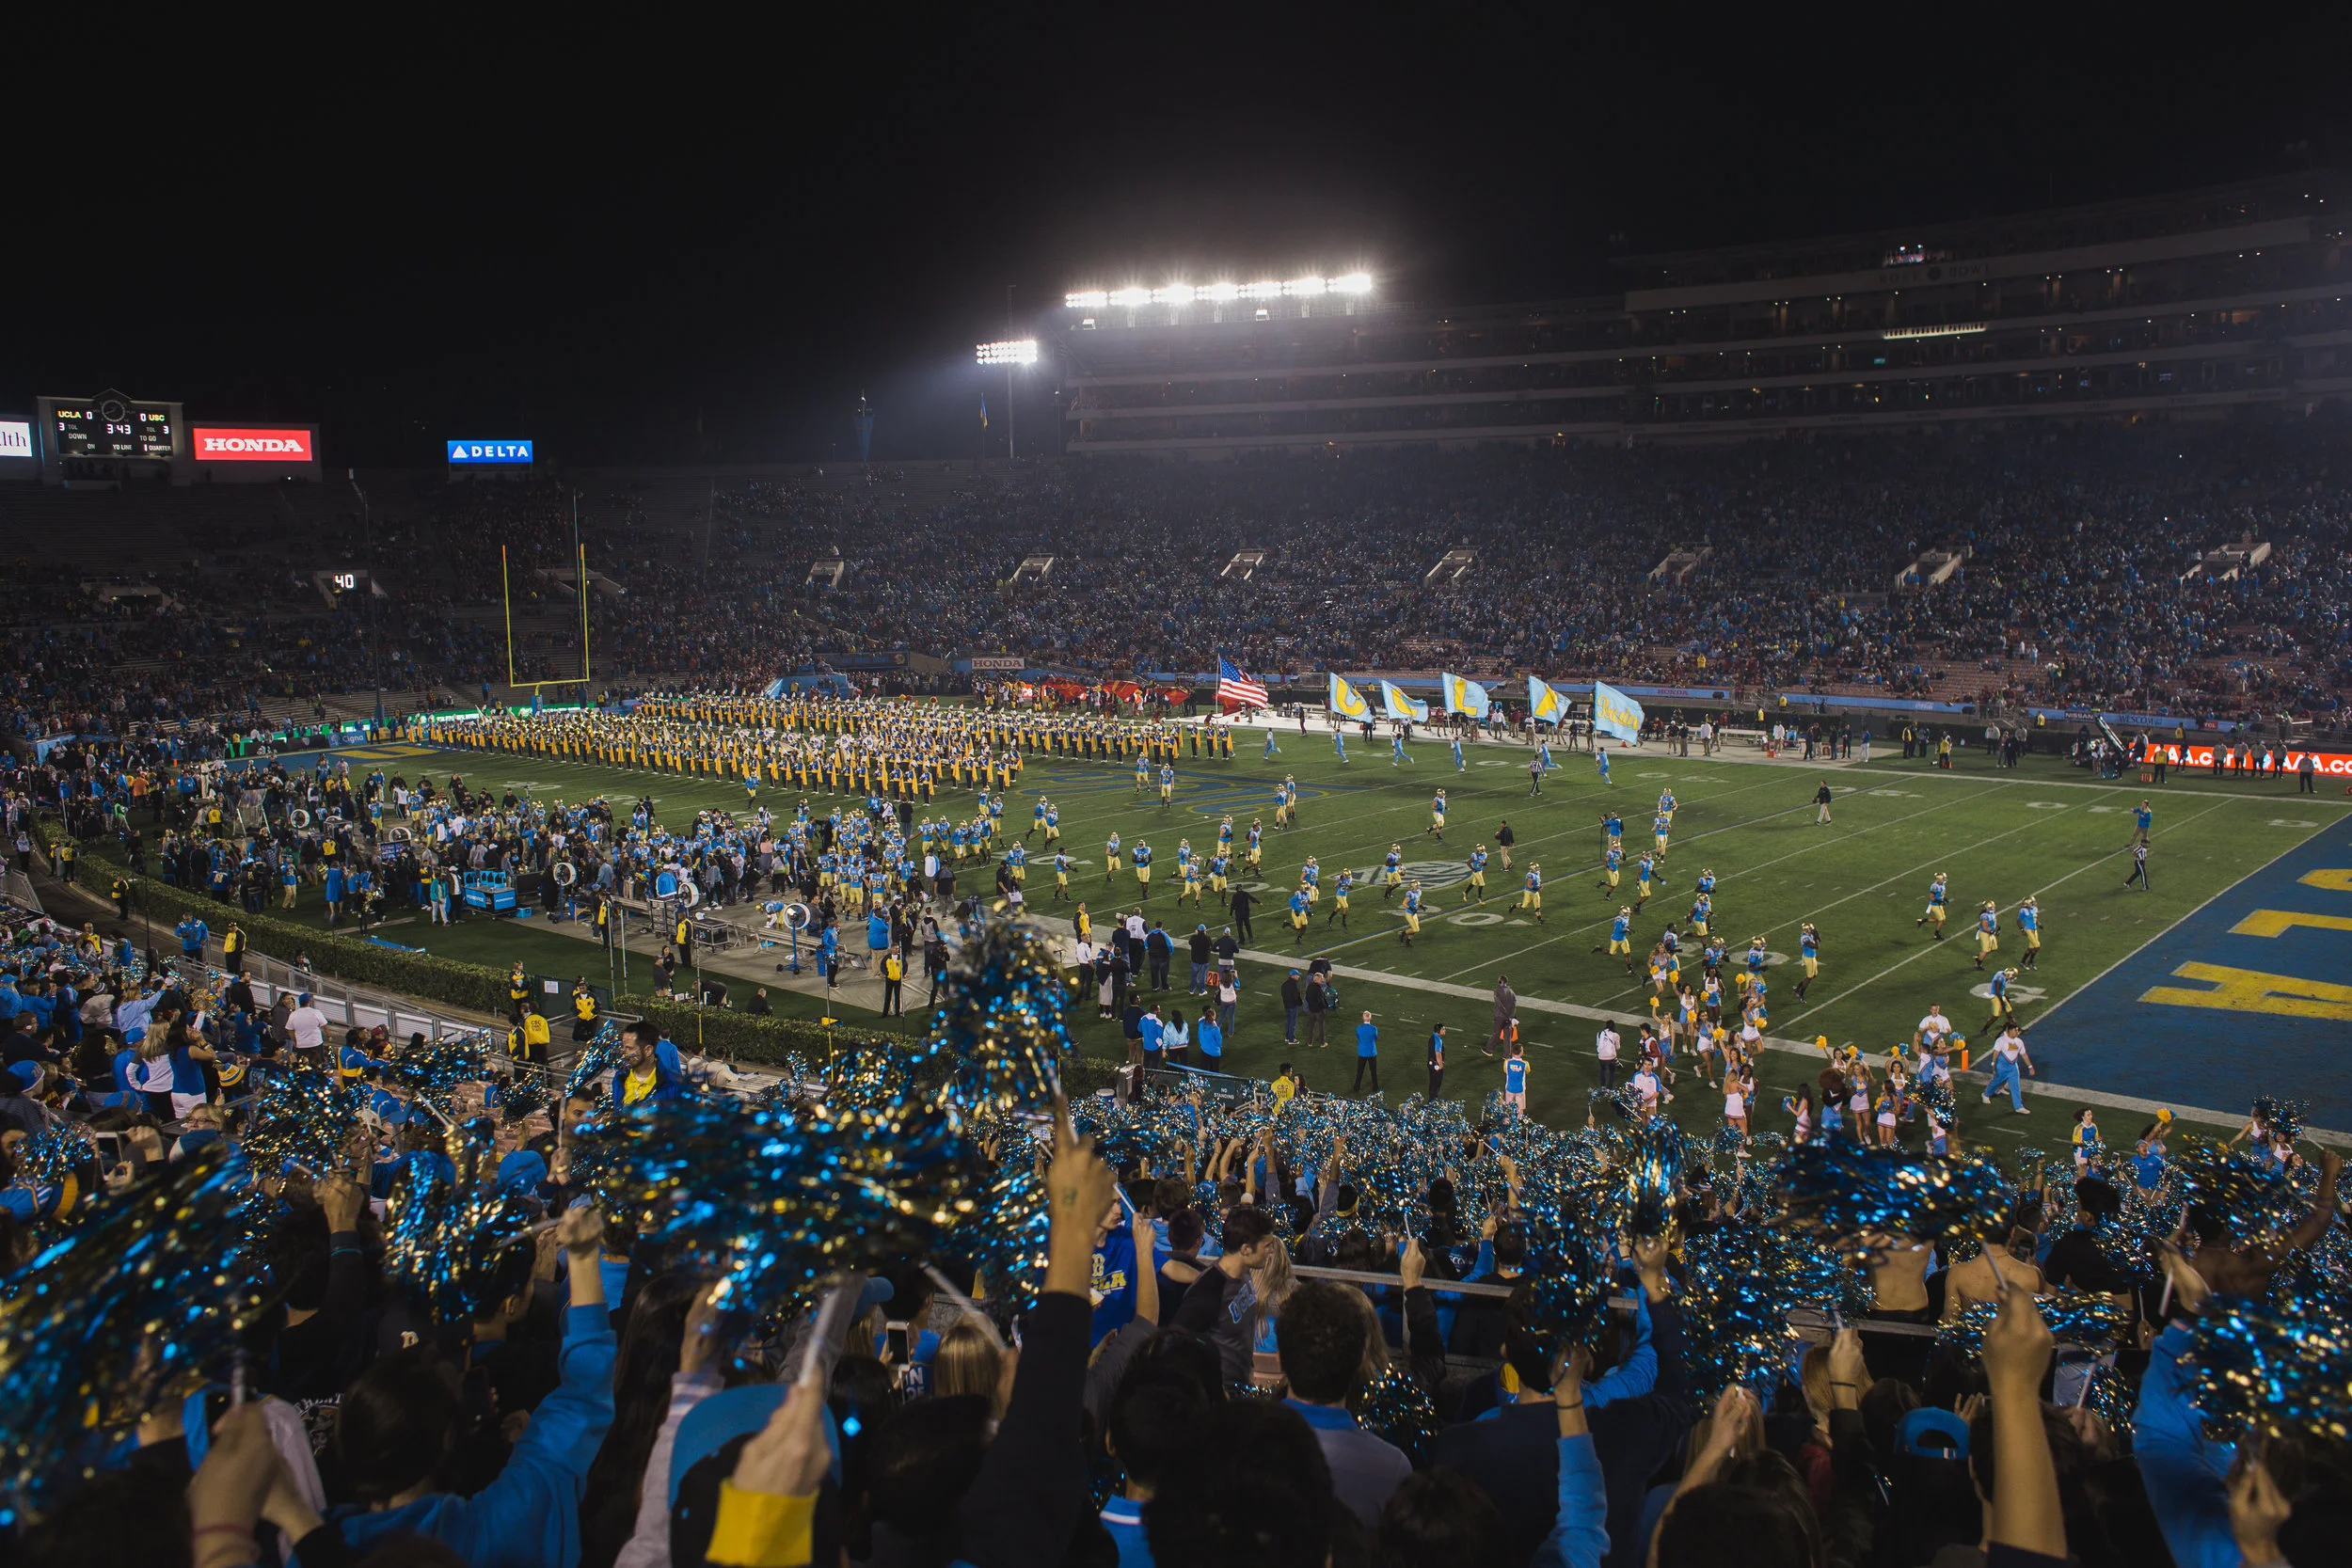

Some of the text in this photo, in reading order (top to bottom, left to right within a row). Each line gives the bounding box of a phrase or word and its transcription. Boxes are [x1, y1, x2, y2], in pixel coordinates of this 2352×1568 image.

[57, 410, 82, 420] UCLA
[87, 411, 93, 420] 0
[140, 413, 147, 421] 0
[58, 422, 66, 431] 3
[106, 424, 132, 435] 3:43
[163, 425, 169, 434] 3
[204, 437, 304, 453] HONDA
[470, 445, 529, 458] DELTA
[334, 574, 355, 589] 40
[973, 659, 1023, 668] HONDA
[2065, 712, 2094, 721] NISSAN
[2119, 714, 2154, 725] WESCOM
[342, 734, 364, 743] Cigna
[1208, 972, 1218, 984] 20
